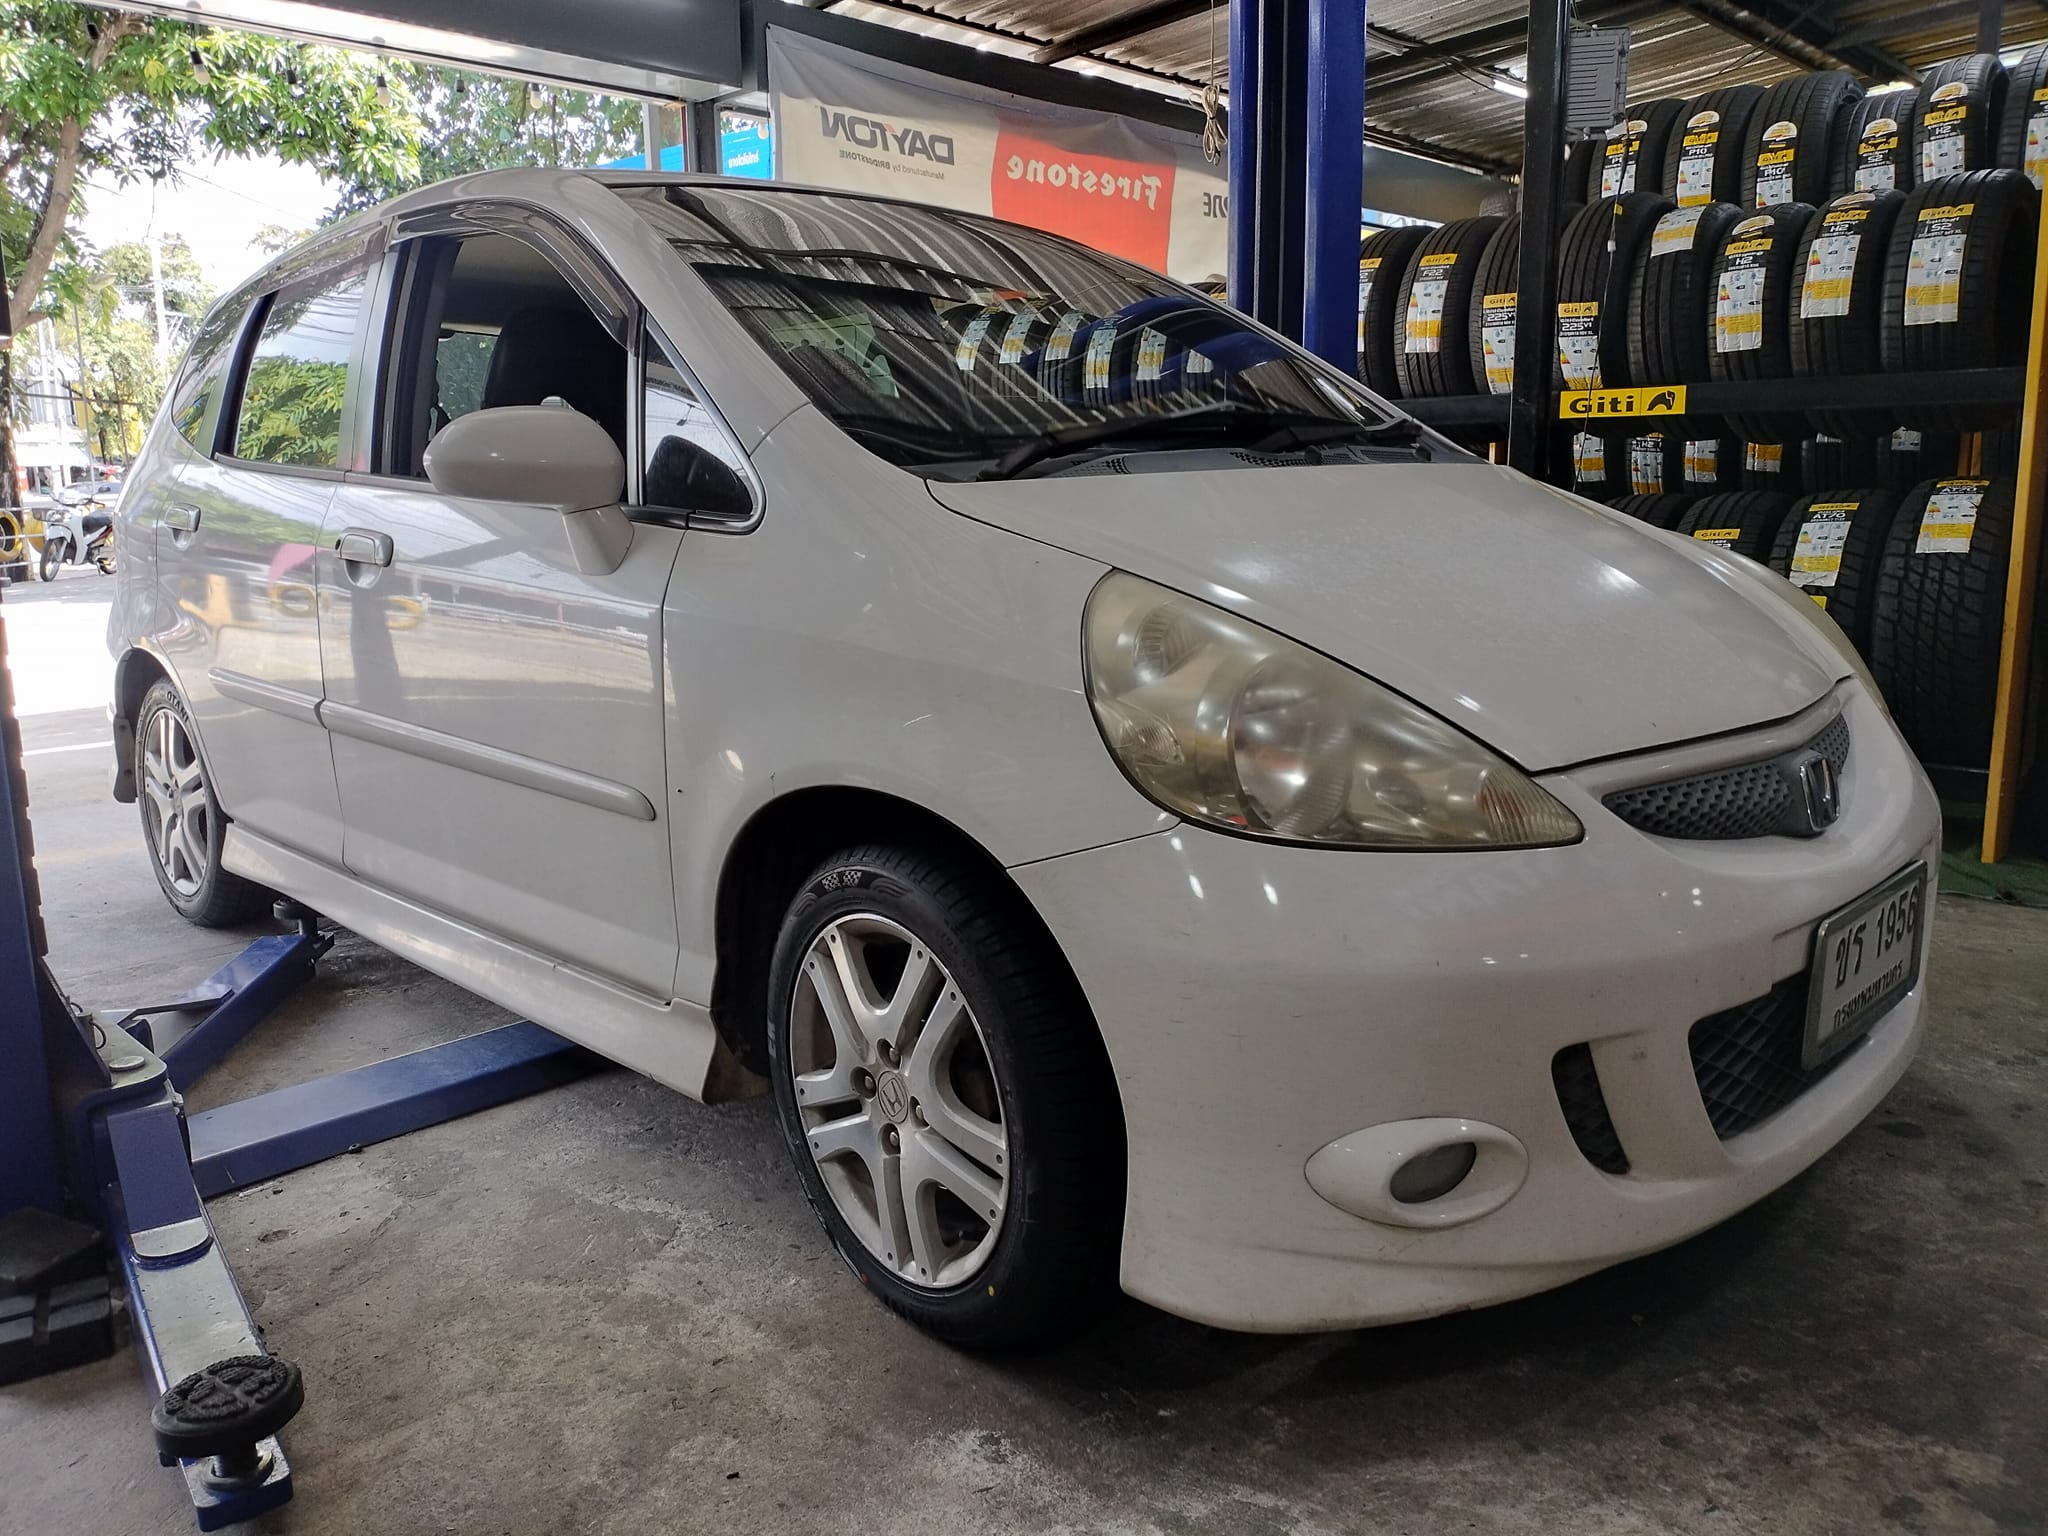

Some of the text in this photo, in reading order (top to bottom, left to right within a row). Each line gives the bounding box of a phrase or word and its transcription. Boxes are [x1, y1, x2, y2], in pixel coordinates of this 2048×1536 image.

[1735, 255, 1754, 266] H2
[1569, 394, 1635, 415] Giti
[1876, 886, 1919, 958] 1956
